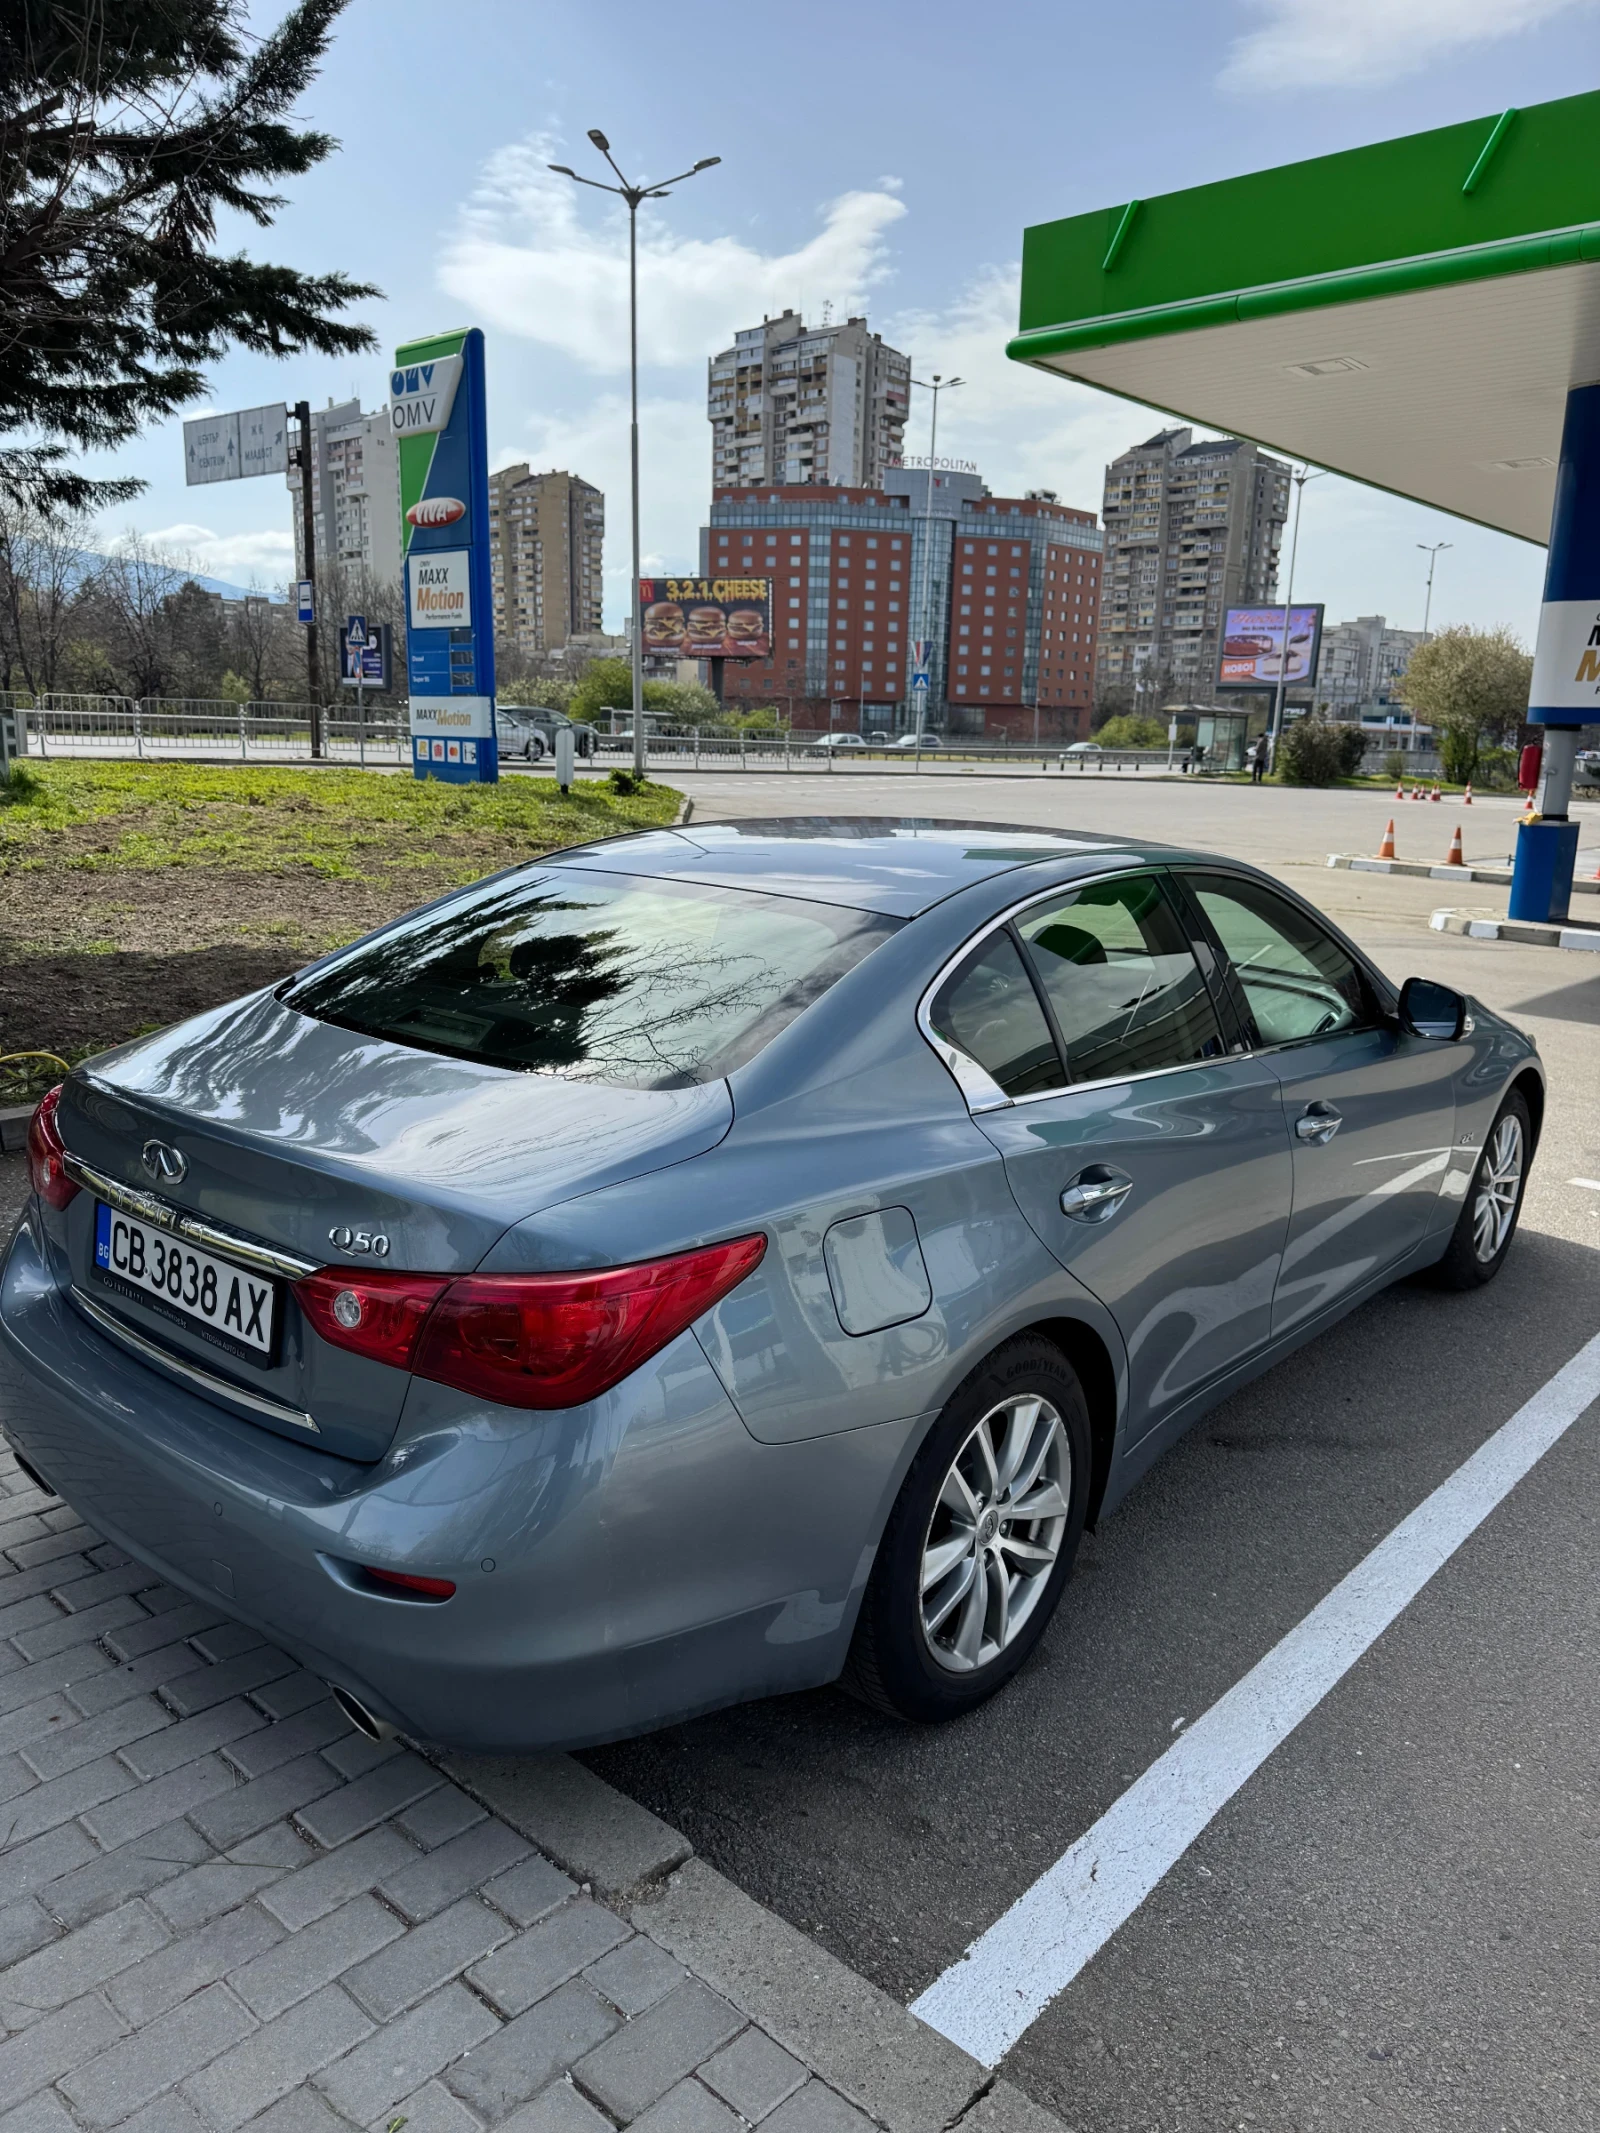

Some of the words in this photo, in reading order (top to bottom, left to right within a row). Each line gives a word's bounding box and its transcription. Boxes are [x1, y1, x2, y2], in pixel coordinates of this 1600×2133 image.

[392, 398, 436, 429] OMV
[199, 455, 226, 468] CENTRUM
[244, 446, 273, 461] МЛАДОСТ
[891, 456, 977, 473] METROPOLITAN
[415, 503, 449, 525] VIVA
[418, 567, 449, 585] MAXX
[417, 586, 464, 611] Motion
[1224, 663, 1253, 674] НОВО!
[98, 1242, 109, 1259] BG
[329, 1226, 390, 1258] Q50
[224, 1276, 268, 1343] AX
[223, 1342, 237, 1355] AUTO
[1006, 1358, 1067, 1381] GOODYEAR
